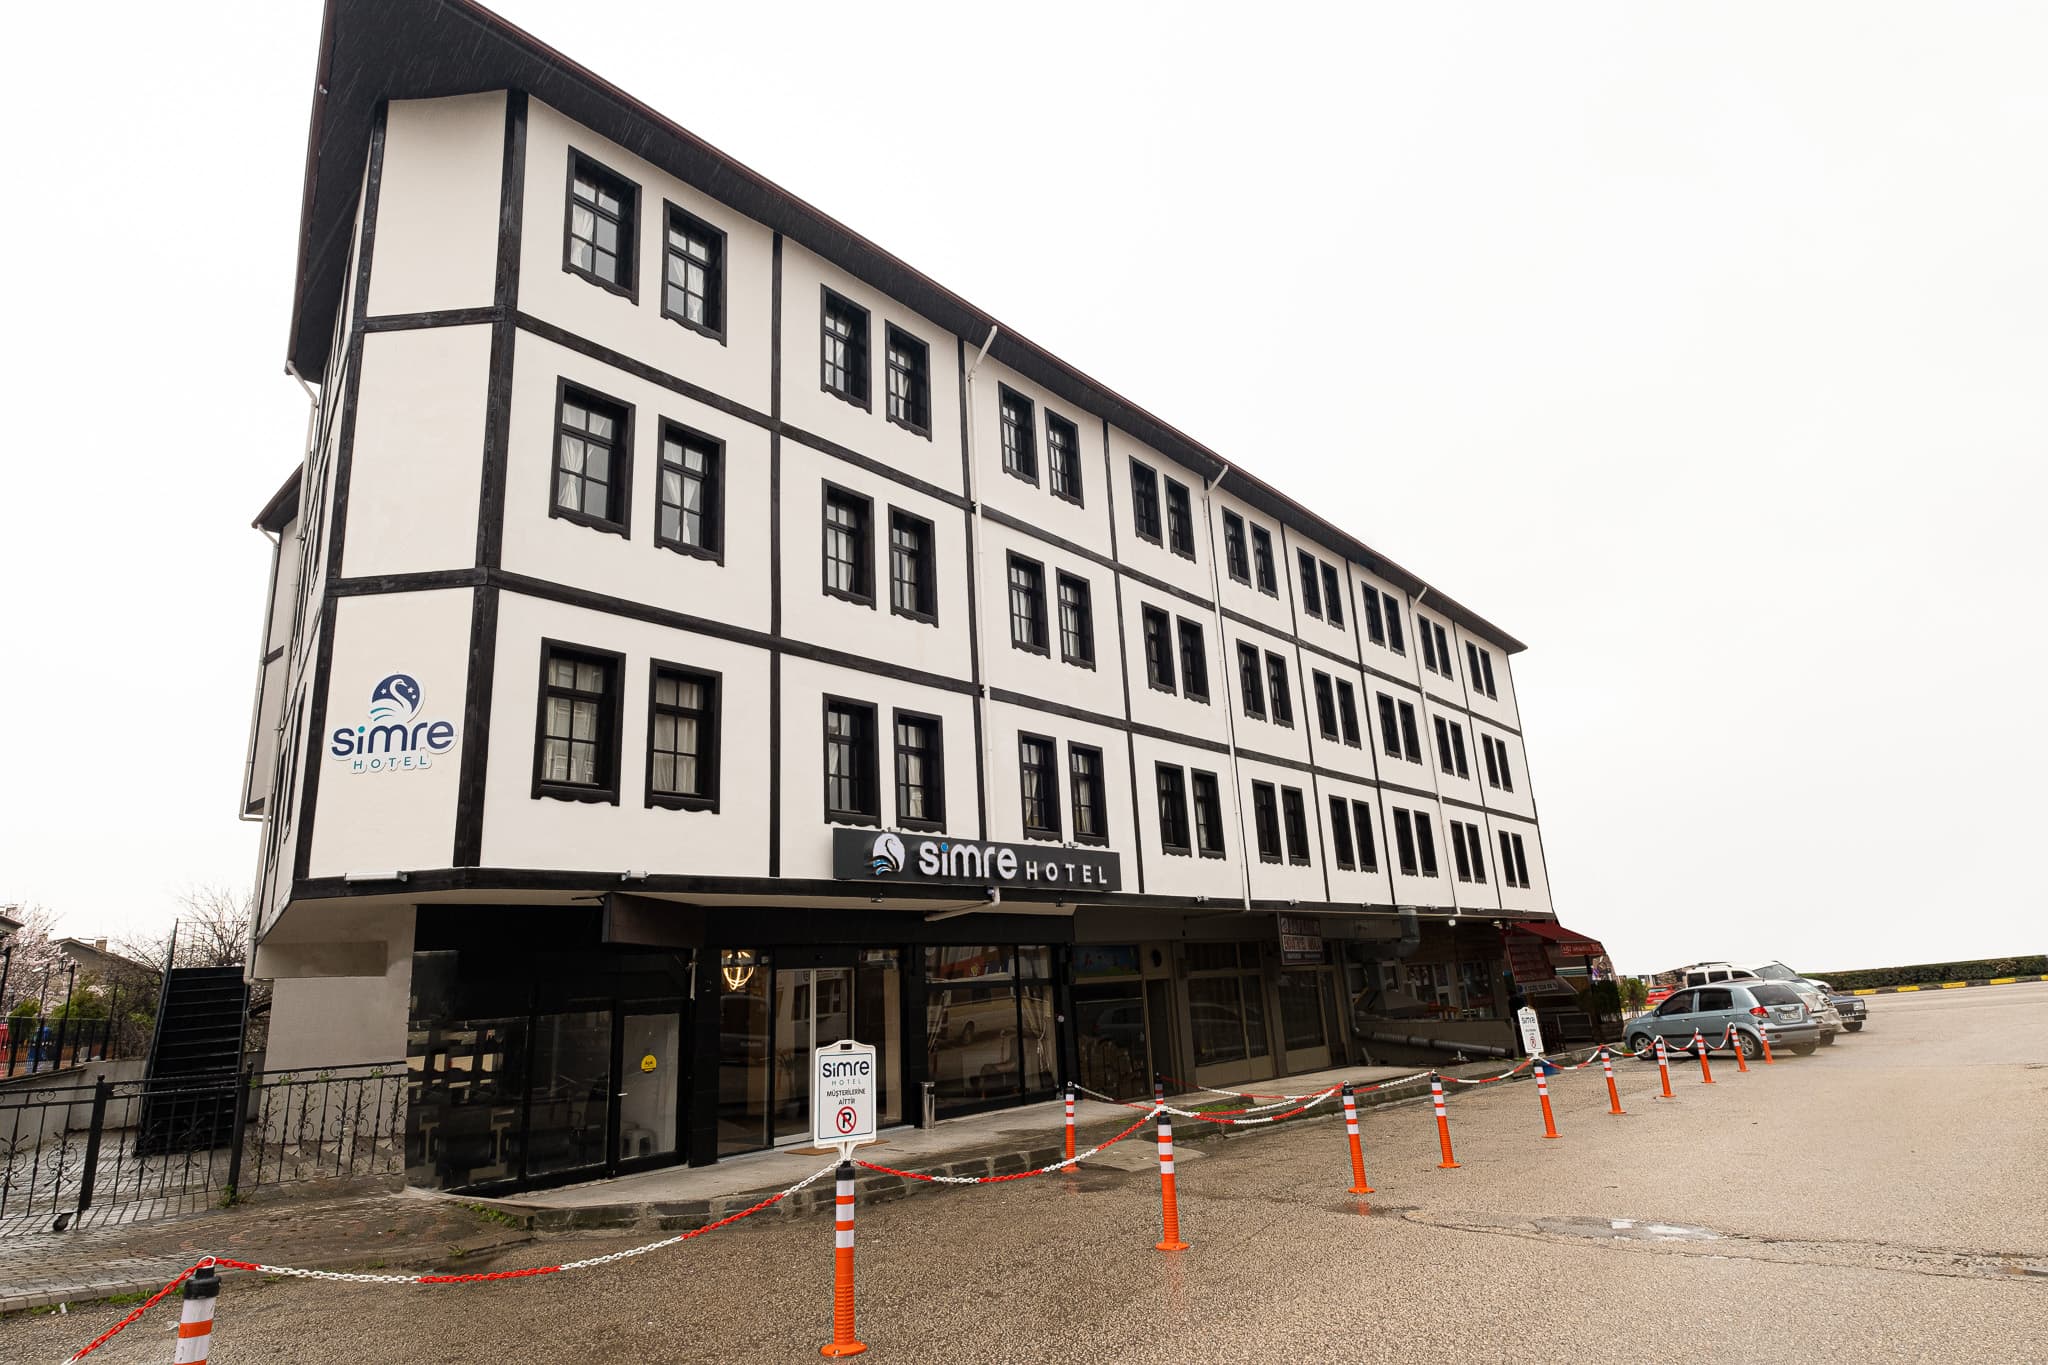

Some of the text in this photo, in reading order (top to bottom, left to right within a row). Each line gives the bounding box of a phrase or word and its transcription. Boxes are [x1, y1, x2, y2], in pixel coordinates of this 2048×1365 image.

[331, 721, 454, 757] simre
[353, 755, 427, 770] HOTEL
[918, 841, 1107, 884] simre HOTEL
[822, 1060, 870, 1078] simre
